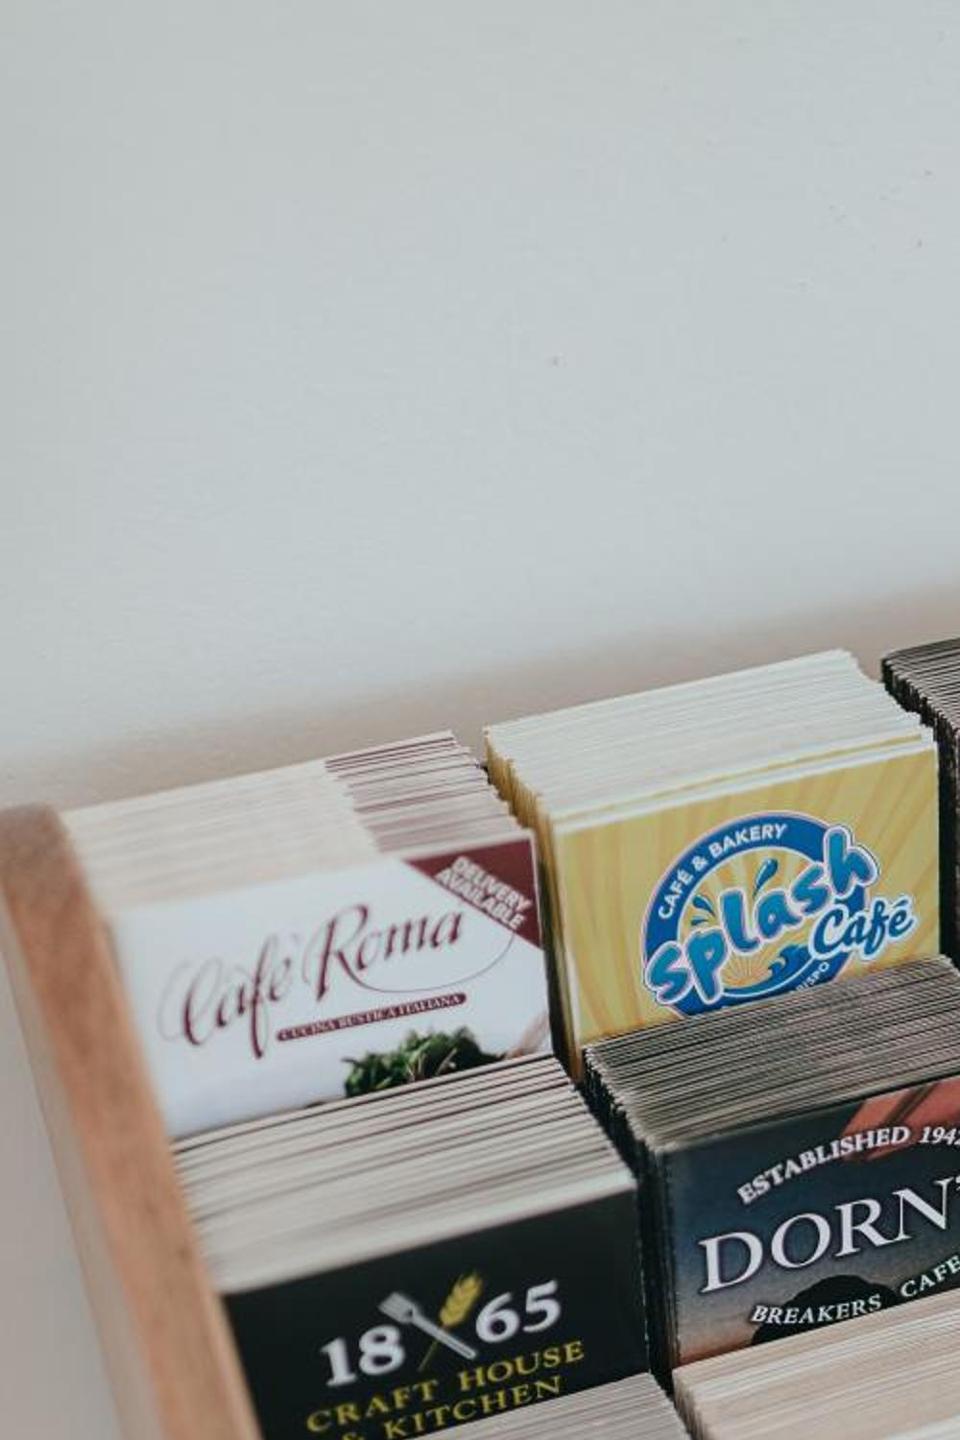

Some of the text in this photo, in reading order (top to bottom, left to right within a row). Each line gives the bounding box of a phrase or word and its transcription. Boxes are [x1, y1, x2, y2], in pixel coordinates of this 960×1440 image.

[434, 868, 525, 930] AVAILABLE
[452, 856, 532, 911] DELIVERY
[658, 823, 788, 919] CAFÉ & BAKERY
[305, 904, 464, 1000] Roma
[811, 896, 915, 959] Café
[736, 1126, 910, 1205] ESTABLISHED
[751, 1292, 883, 1324] BREAKERS
[306, 1340, 585, 1433] CRAFT HOUSE
[385, 1376, 564, 1440] KITCHEN
